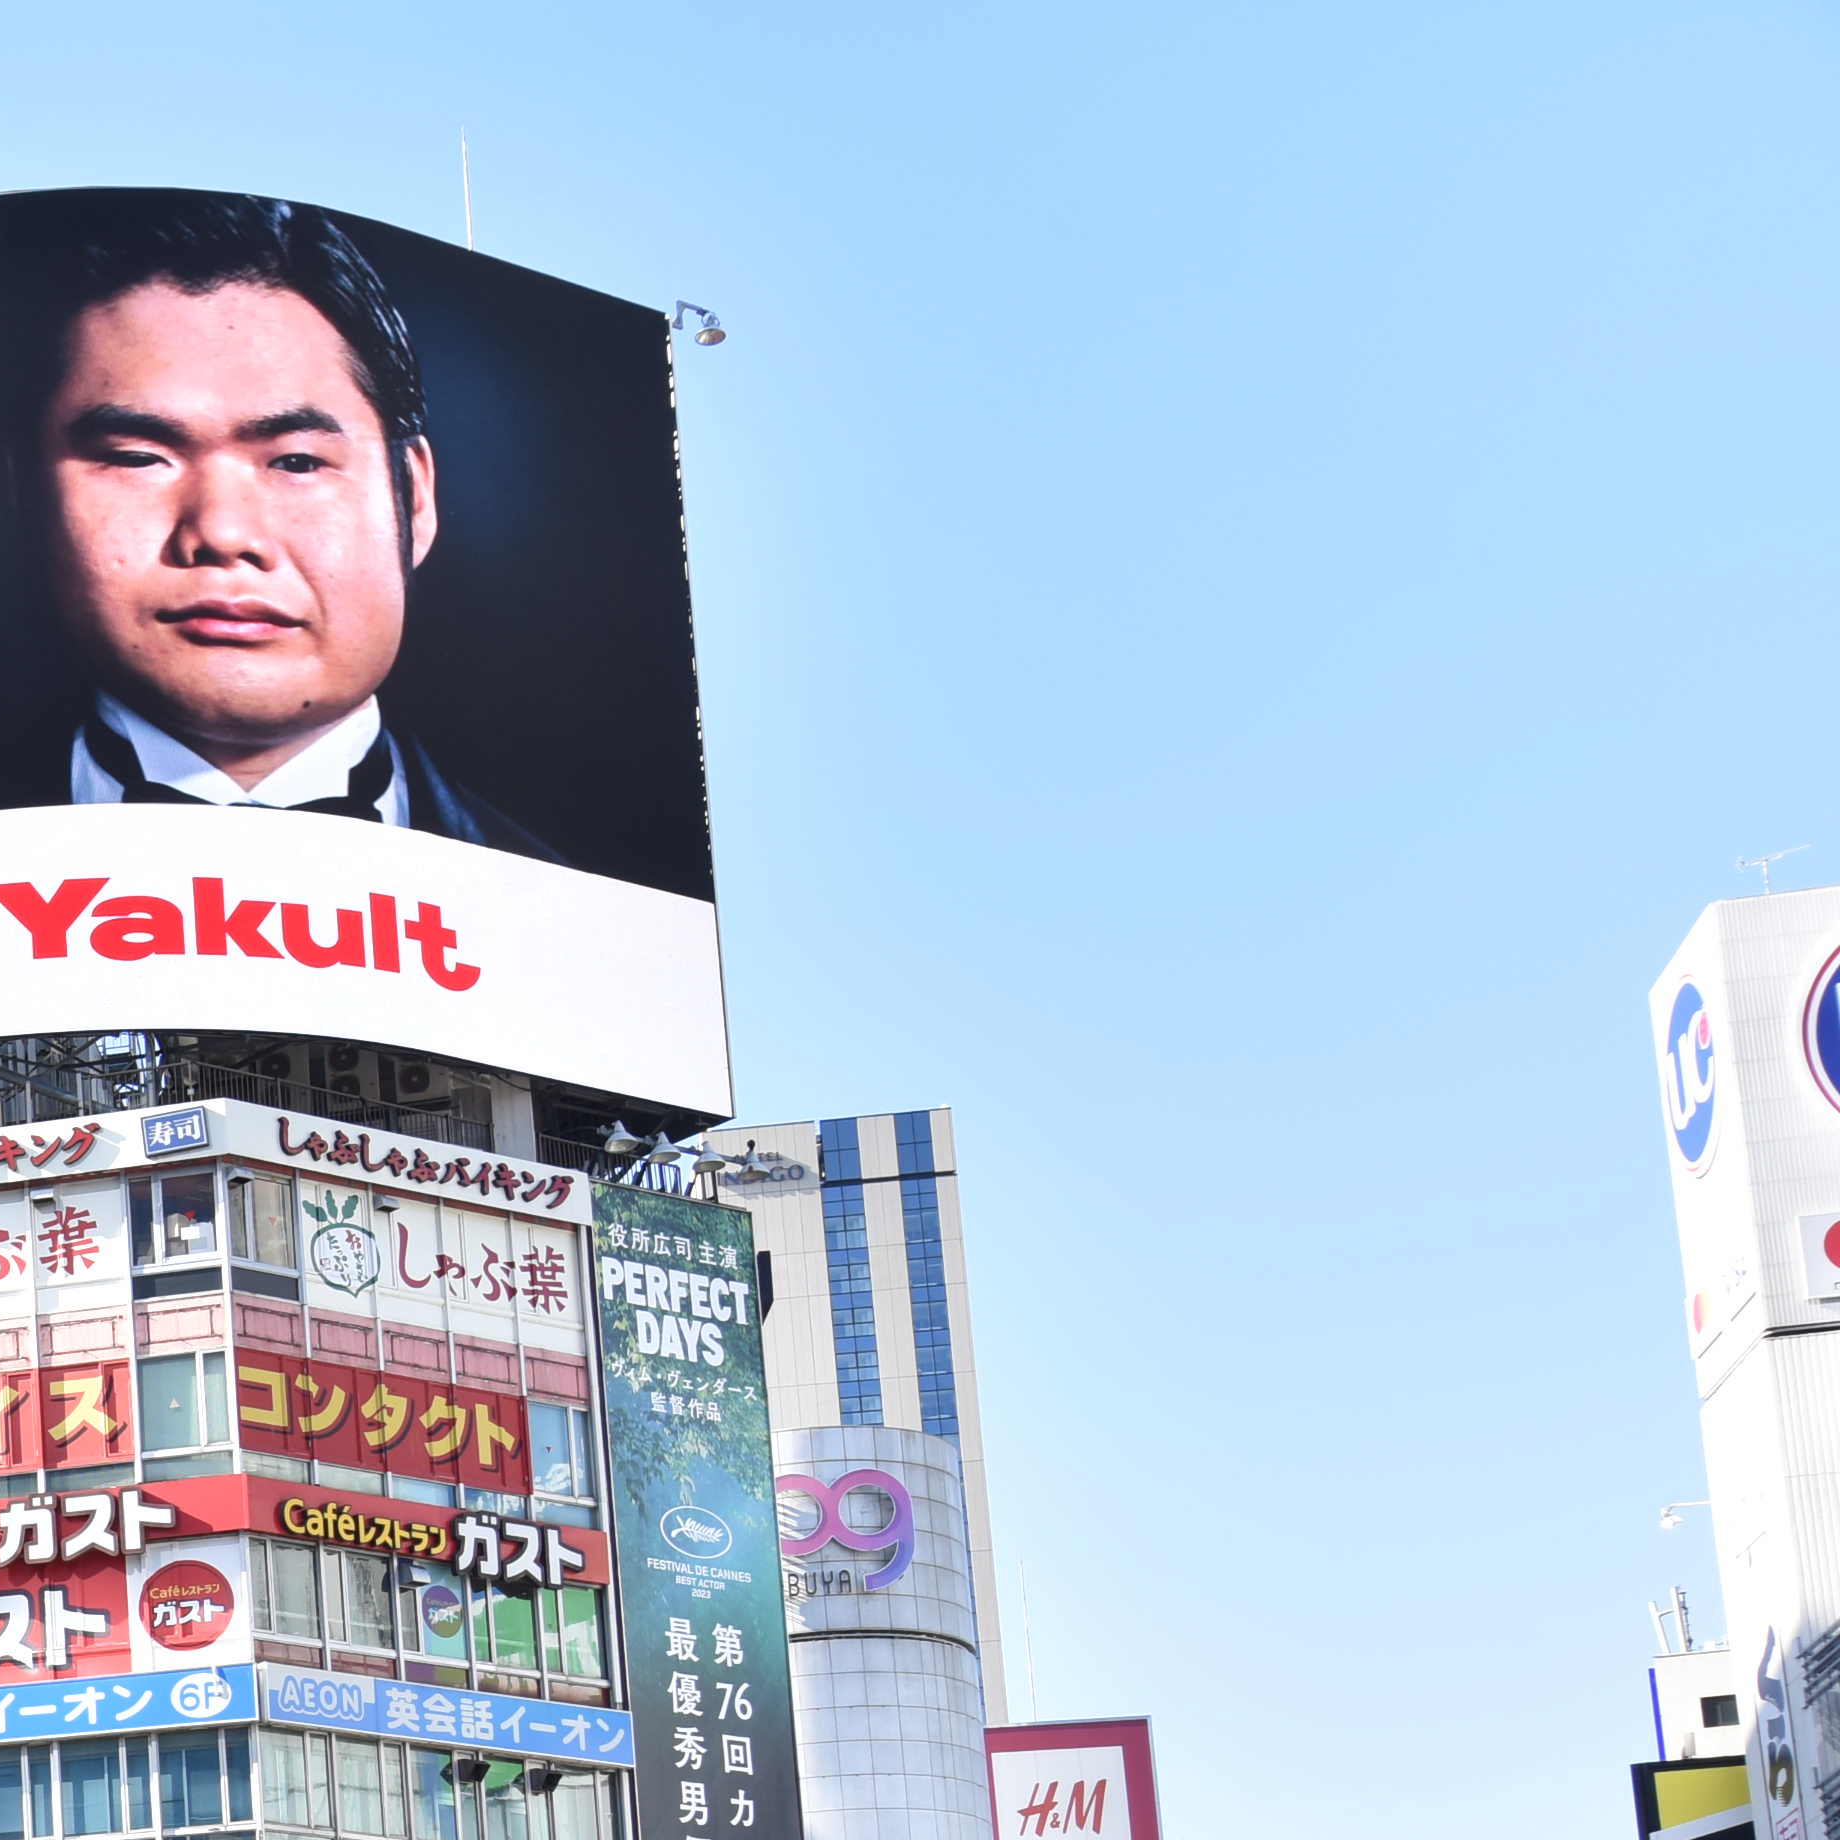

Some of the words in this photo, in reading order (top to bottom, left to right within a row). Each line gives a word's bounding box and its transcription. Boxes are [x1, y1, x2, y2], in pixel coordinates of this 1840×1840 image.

[147, 1112, 203, 1147] 寿司
[276, 1116, 575, 1209] しゃぶしゃぶバイキング
[397, 1221, 569, 1316] しゃぶ葉
[607, 1222, 692, 1260] 役所広司
[698, 1240, 739, 1271] 主演
[601, 1256, 750, 1327] PERFECT
[636, 1309, 725, 1367] DAYS
[610, 1359, 758, 1402] ヴィム・ヴェンダース
[237, 1364, 518, 1468] コンタクト
[650, 1391, 722, 1423] 監督作品
[455, 1512, 585, 1587] ガスト
[646, 1556, 694, 1576] FESTIVAL
[694, 1565, 709, 1578] DE
[709, 1567, 752, 1585] CANNES
[675, 1575, 696, 1587] BEST
[696, 1578, 725, 1591] ACTOR
[691, 1588, 712, 1600] 2023
[787, 1570, 853, 1598] BUYA
[153, 1598, 225, 1628] ガスト
[179, 1679, 225, 1713] 6F
[280, 1675, 363, 1720] AEON
[385, 1687, 625, 1753] 英会話イーオン
[1016, 1777, 1108, 1838] H&M
